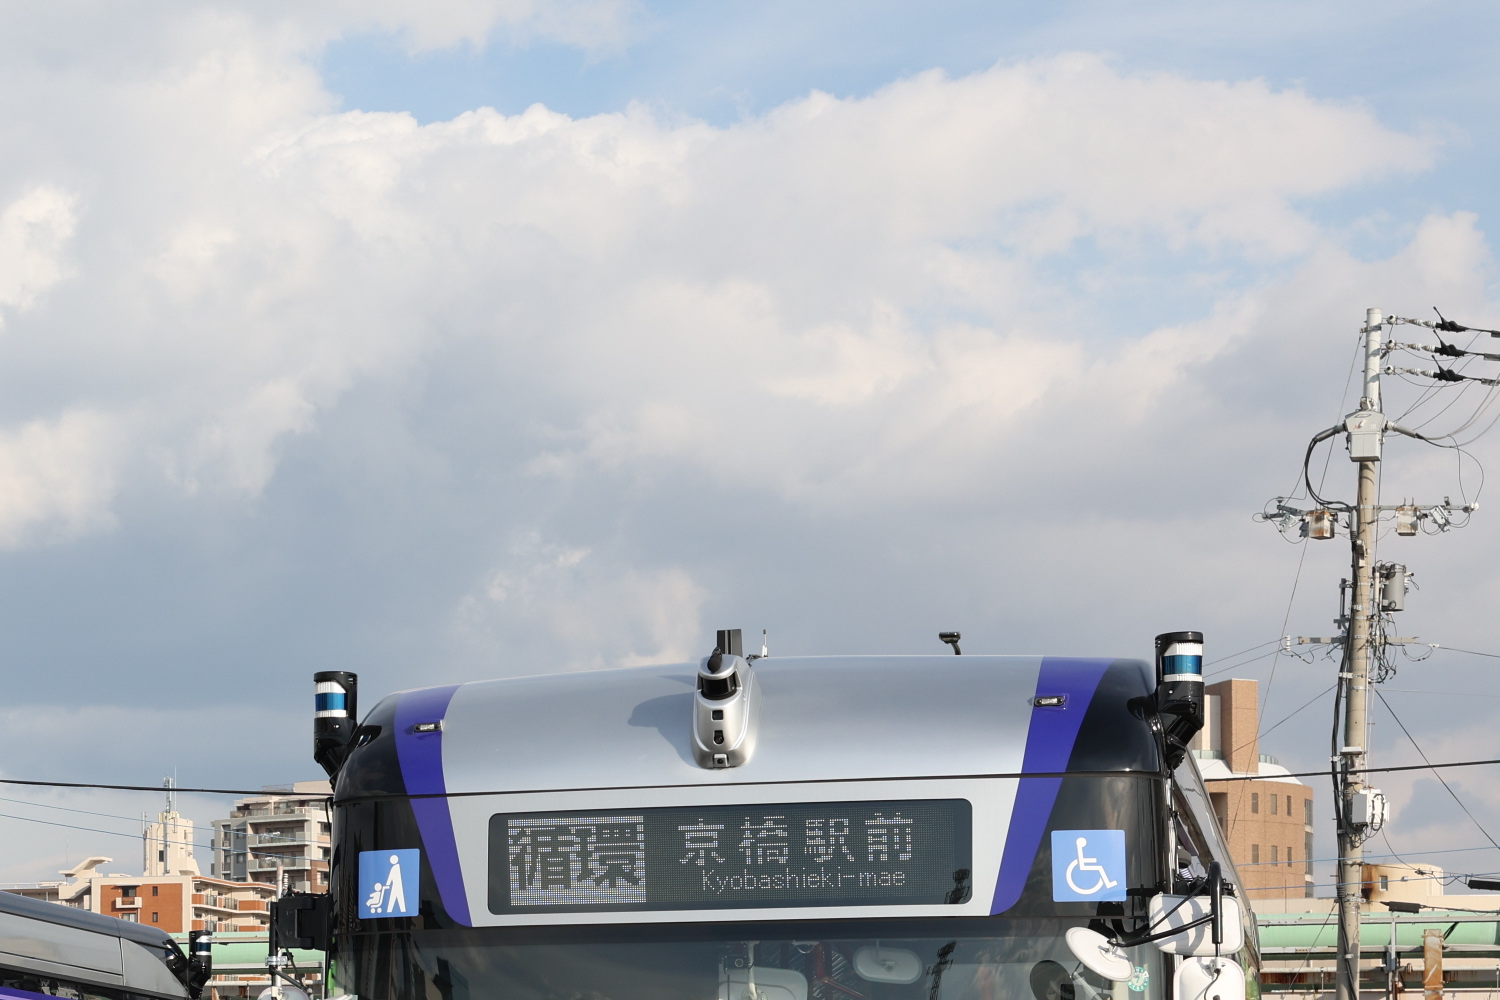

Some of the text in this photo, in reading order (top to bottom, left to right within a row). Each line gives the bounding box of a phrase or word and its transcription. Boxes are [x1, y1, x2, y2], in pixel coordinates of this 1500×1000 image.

[508, 813, 913, 898] 循環 京橋駅前
[702, 869, 906, 894] Kyobashieki-mae
